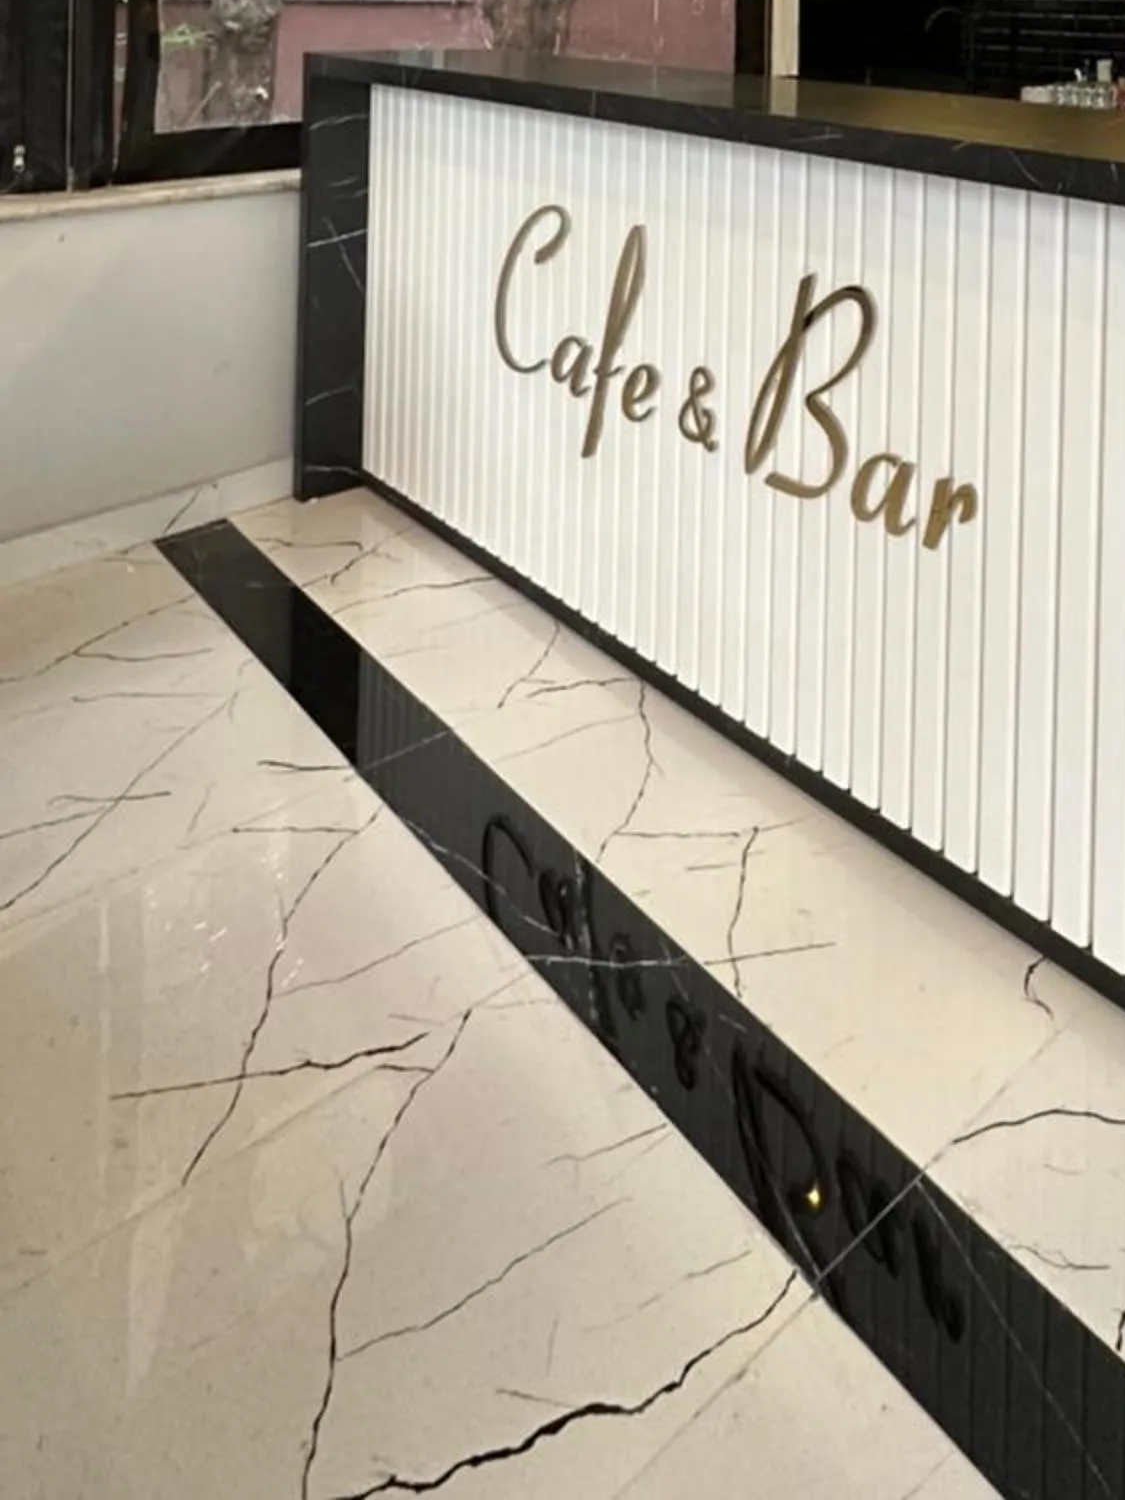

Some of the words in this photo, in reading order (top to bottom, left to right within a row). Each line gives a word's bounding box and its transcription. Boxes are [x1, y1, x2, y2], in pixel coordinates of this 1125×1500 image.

[495, 204, 661, 459] Cafe
[678, 366, 718, 452] &
[745, 272, 977, 550] Bar
